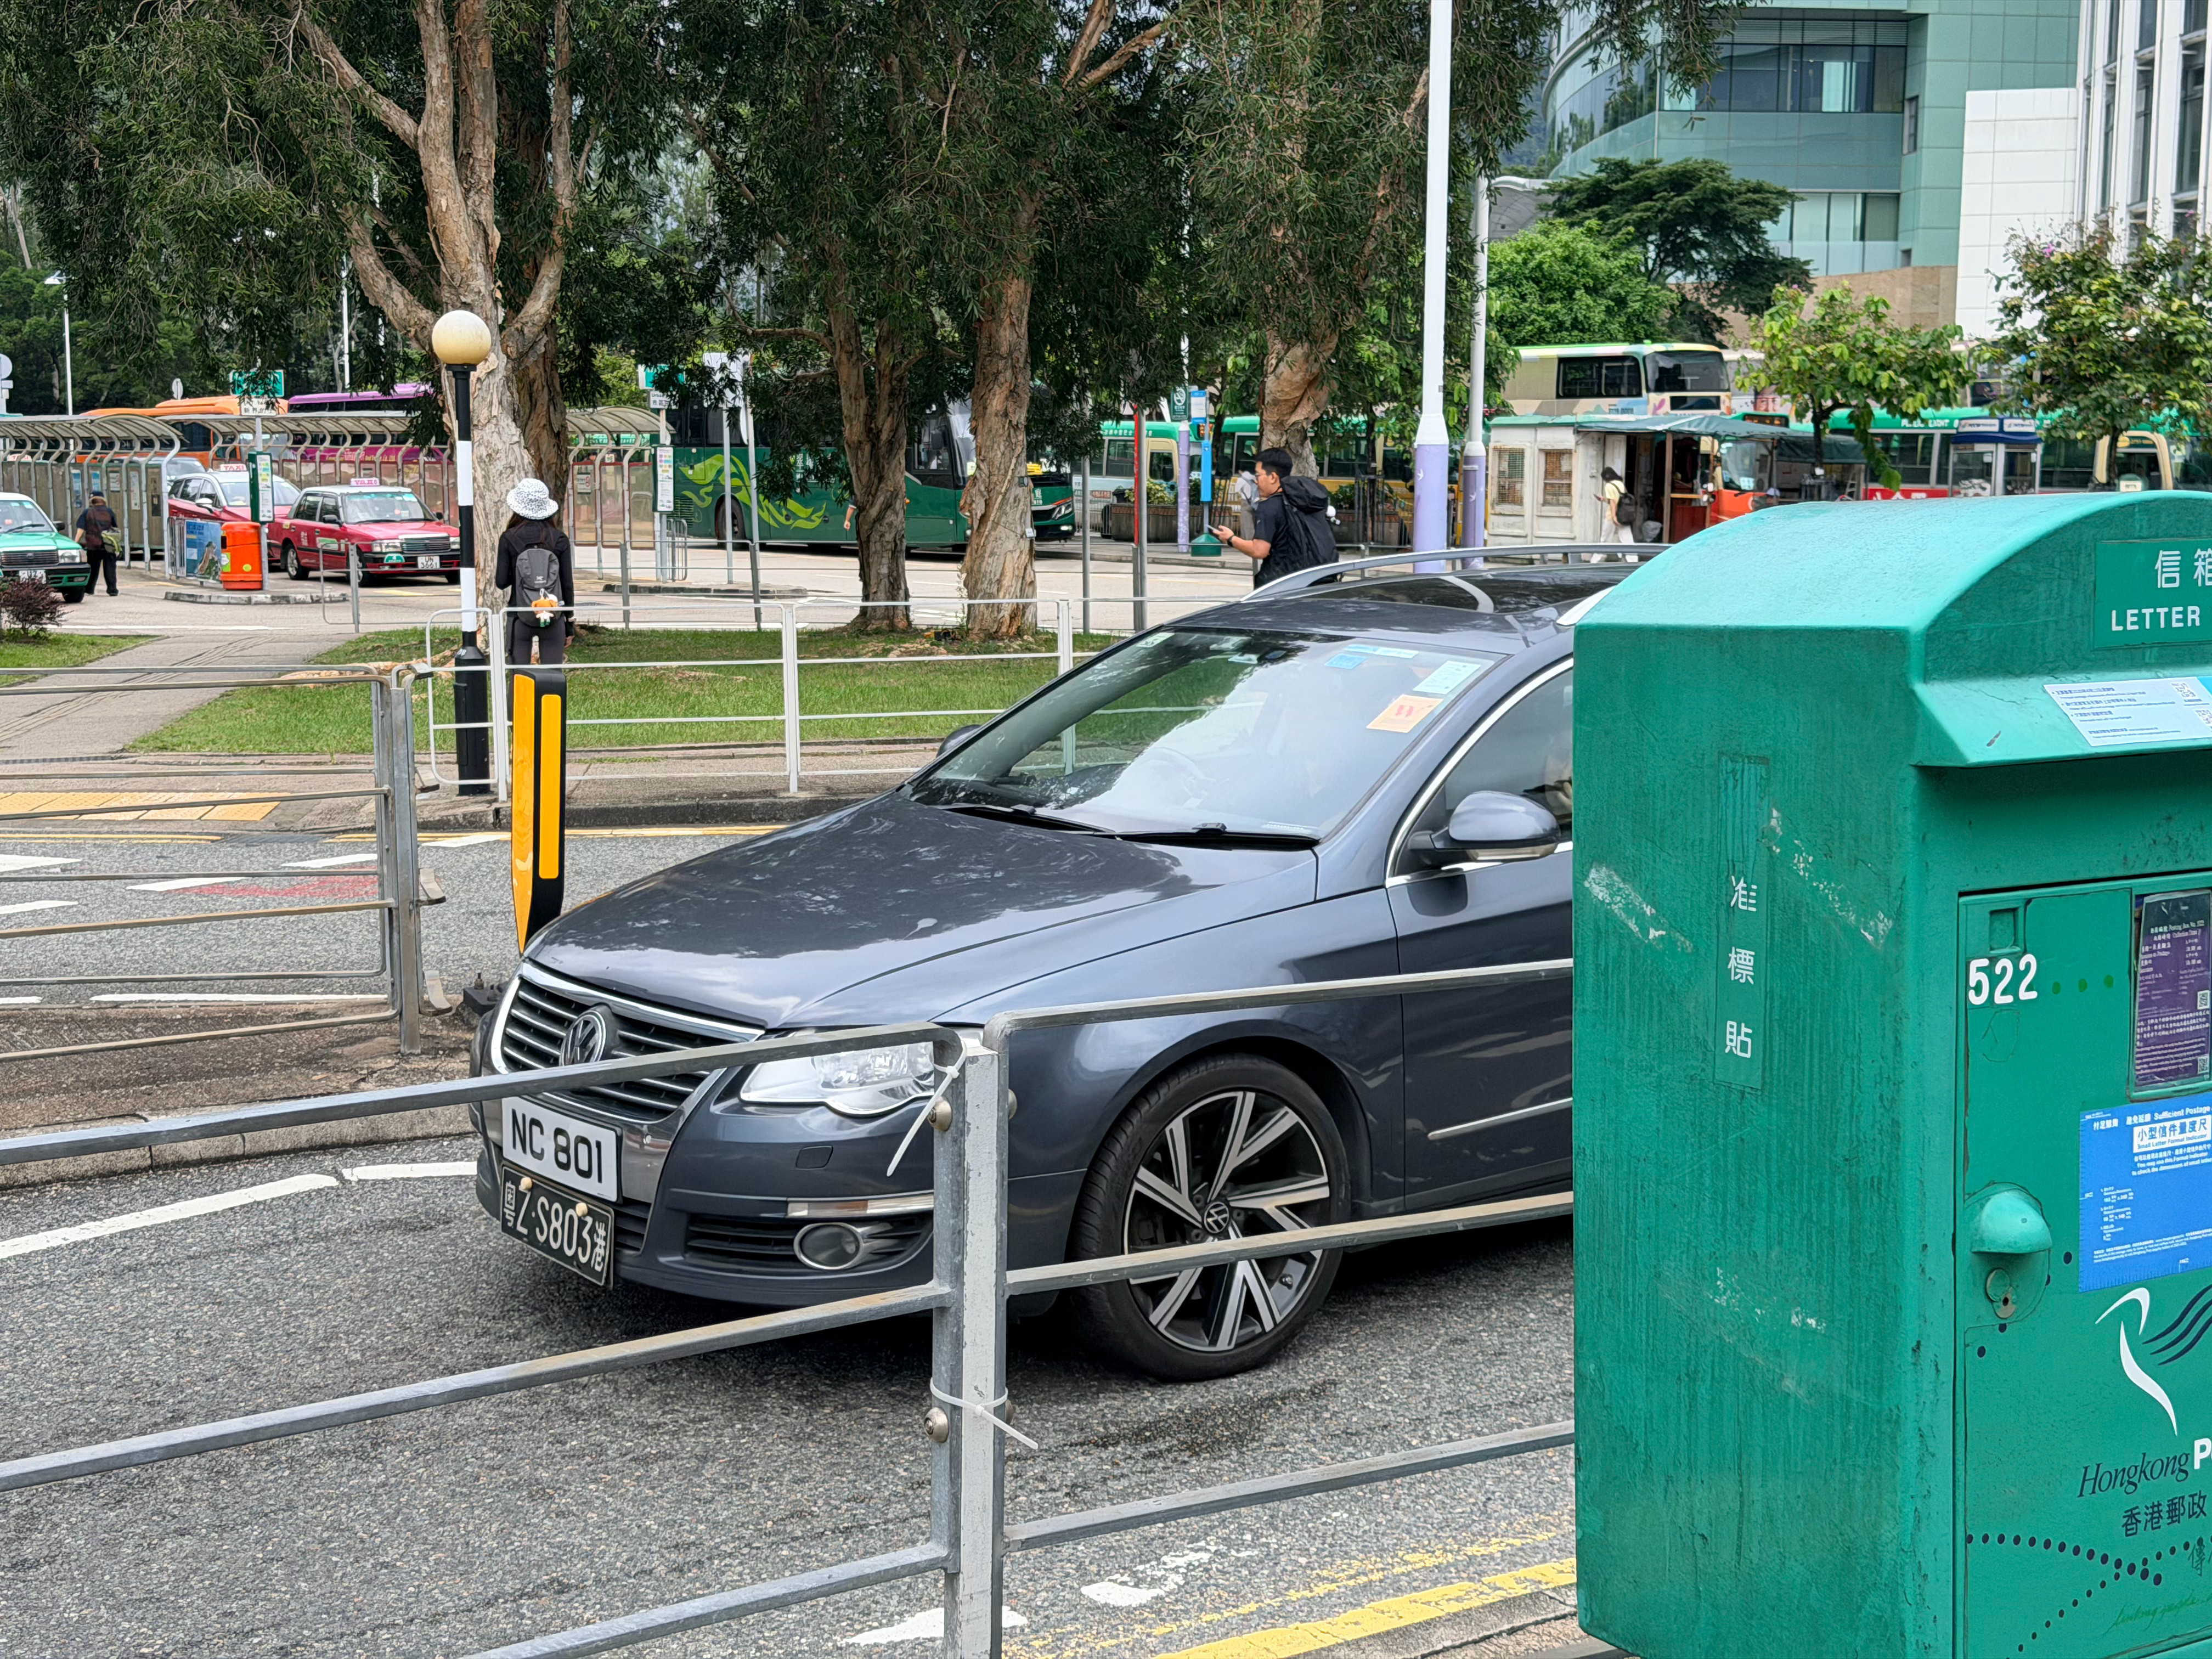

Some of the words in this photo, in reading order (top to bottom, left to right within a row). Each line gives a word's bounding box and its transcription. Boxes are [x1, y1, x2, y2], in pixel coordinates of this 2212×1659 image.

[2154, 548, 2212, 588] 信箱
[2112, 606, 2200, 631] LETTER
[1968, 953, 2038, 1005] 522
[2137, 1118, 2207, 1142] 小型信件量度尺
[2154, 1109, 2184, 1120] Sufficient
[2186, 1106, 2210, 1115] Postage
[512, 1108, 545, 1161] NC
[554, 1127, 602, 1184] 801
[2077, 1452, 2191, 1498] Hongkong
[2194, 1438, 2212, 1470] P
[2121, 1489, 2207, 1537] 香港郵政
